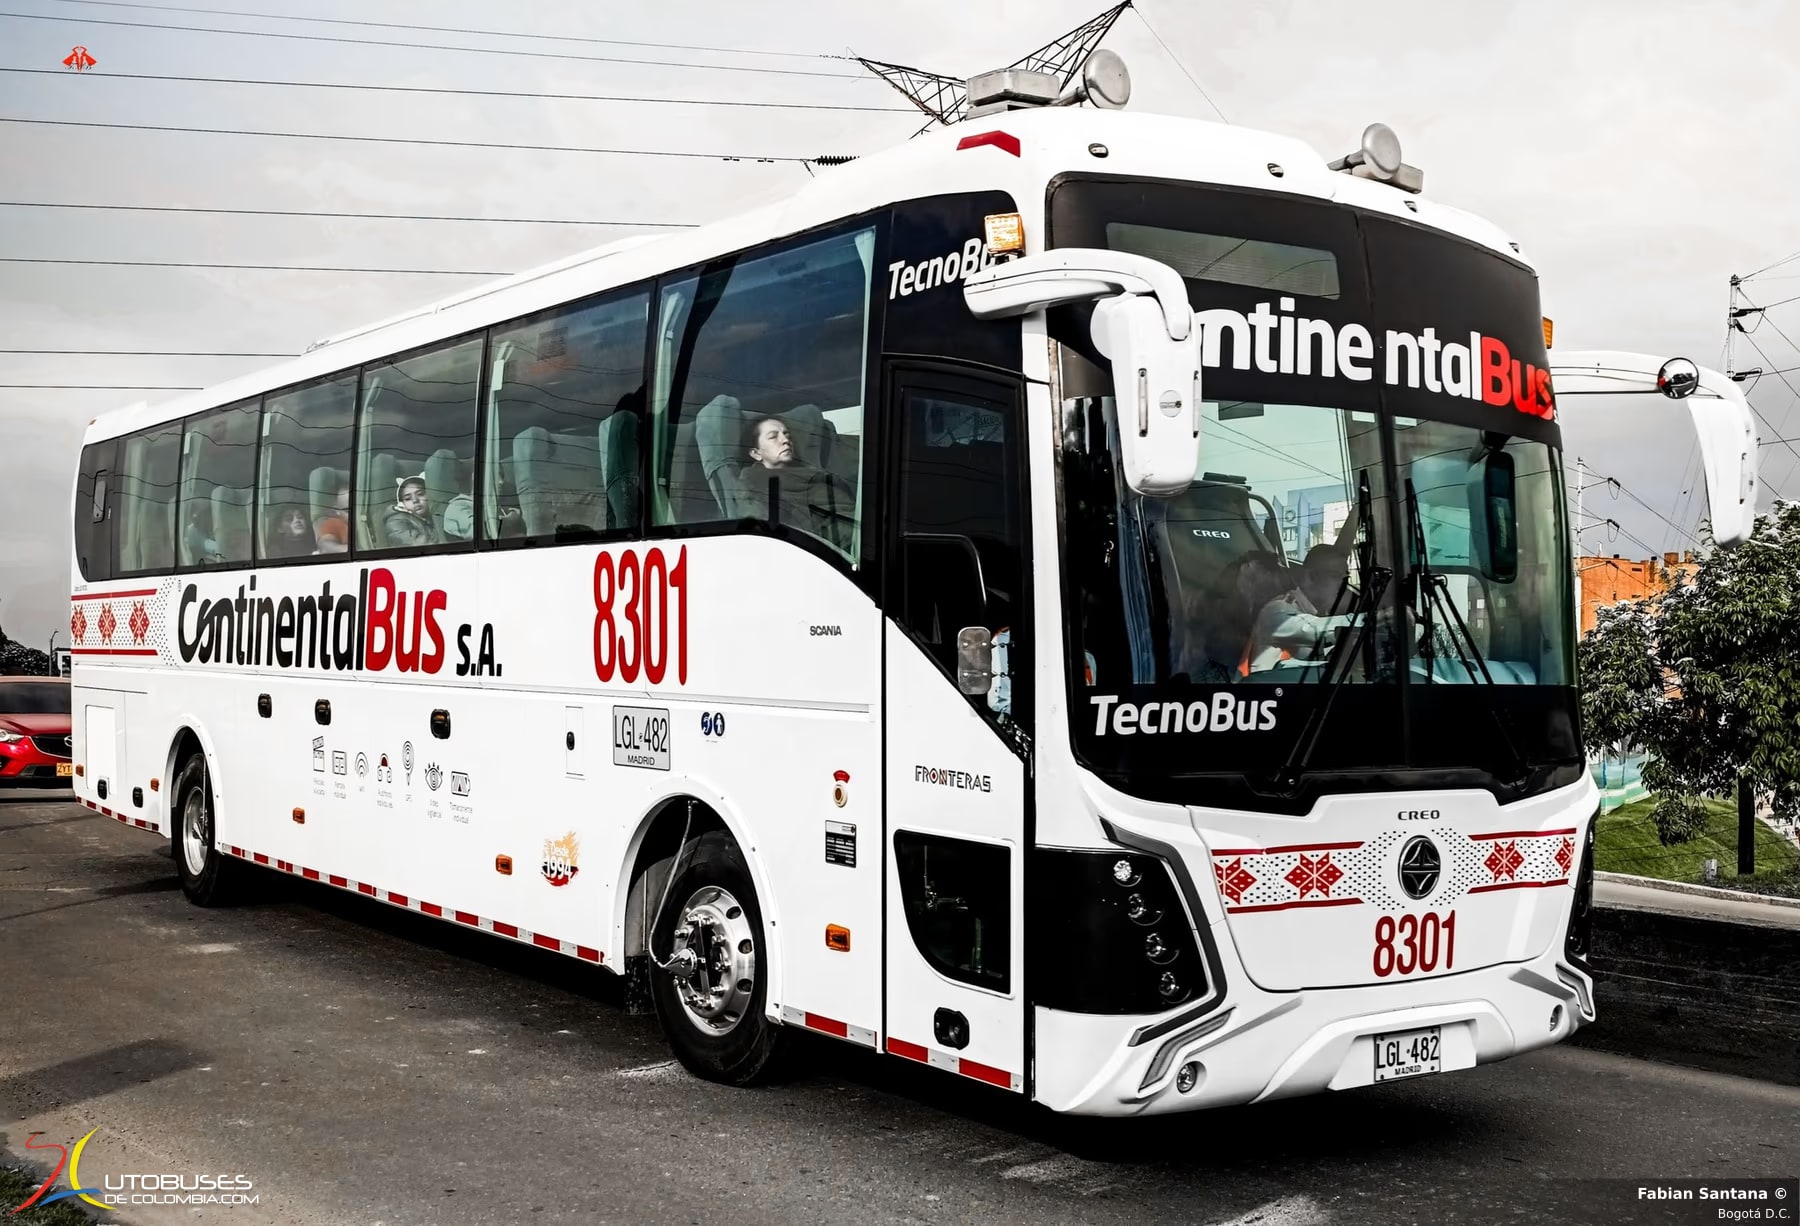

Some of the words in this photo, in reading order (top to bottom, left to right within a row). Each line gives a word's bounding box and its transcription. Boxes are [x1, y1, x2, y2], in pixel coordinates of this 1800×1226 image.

[889, 238, 996, 300] TecnoBu
[1195, 297, 1554, 420] ntinentalBus
[1192, 528, 1231, 541] CREO
[178, 568, 447, 674] ContinentalBus
[457, 623, 502, 677] S.A.
[594, 544, 687, 686] 8301
[809, 625, 842, 637] SCANIA
[57, 765, 73, 774] ZYT
[627, 755, 656, 766] MADRID
[914, 764, 991, 793] FRONTERAS
[1397, 809, 1440, 821] CREO
[544, 856, 572, 880] 1994
[1373, 910, 1456, 977] 8301
[1394, 1064, 1422, 1075] MADRID
